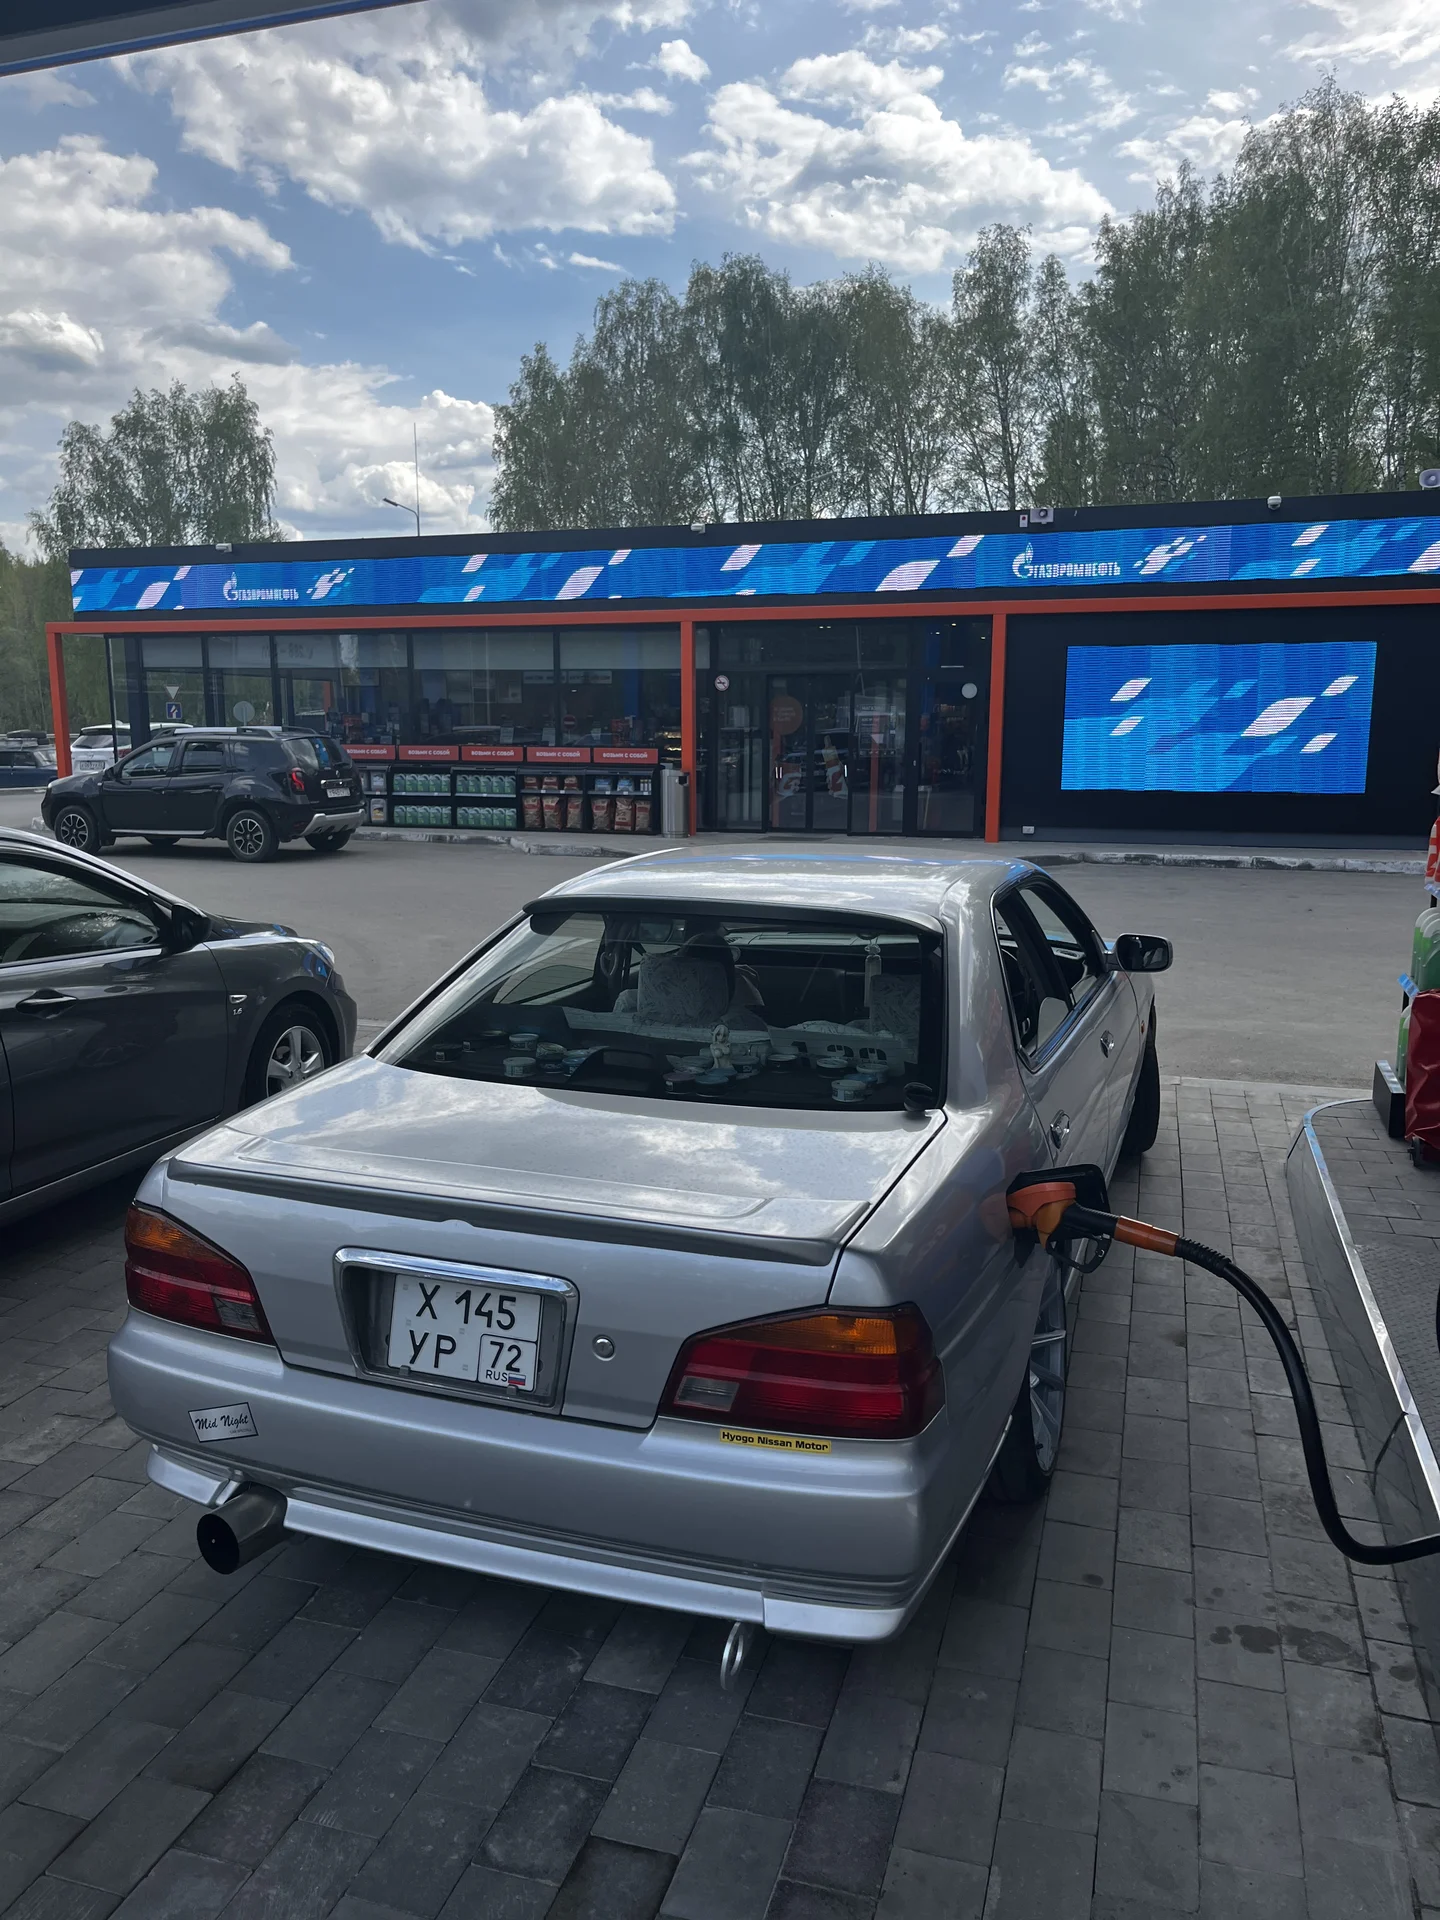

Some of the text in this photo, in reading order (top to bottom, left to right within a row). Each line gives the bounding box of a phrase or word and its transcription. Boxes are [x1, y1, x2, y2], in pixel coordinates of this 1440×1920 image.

[1033, 562, 1121, 578] ГАЗПРОМНЕФТЬ
[562, 750, 580, 758] СОБОЙ
[629, 751, 648, 759] СОБОЙ
[233, 1007, 243, 1016] 1.6
[415, 1282, 517, 1331] Х 145
[409, 1329, 522, 1373] УР 72
[485, 1369, 508, 1383] RUS
[195, 1412, 249, 1430] Mid Night
[722, 1431, 829, 1451] Hyogo Nissan Motor
